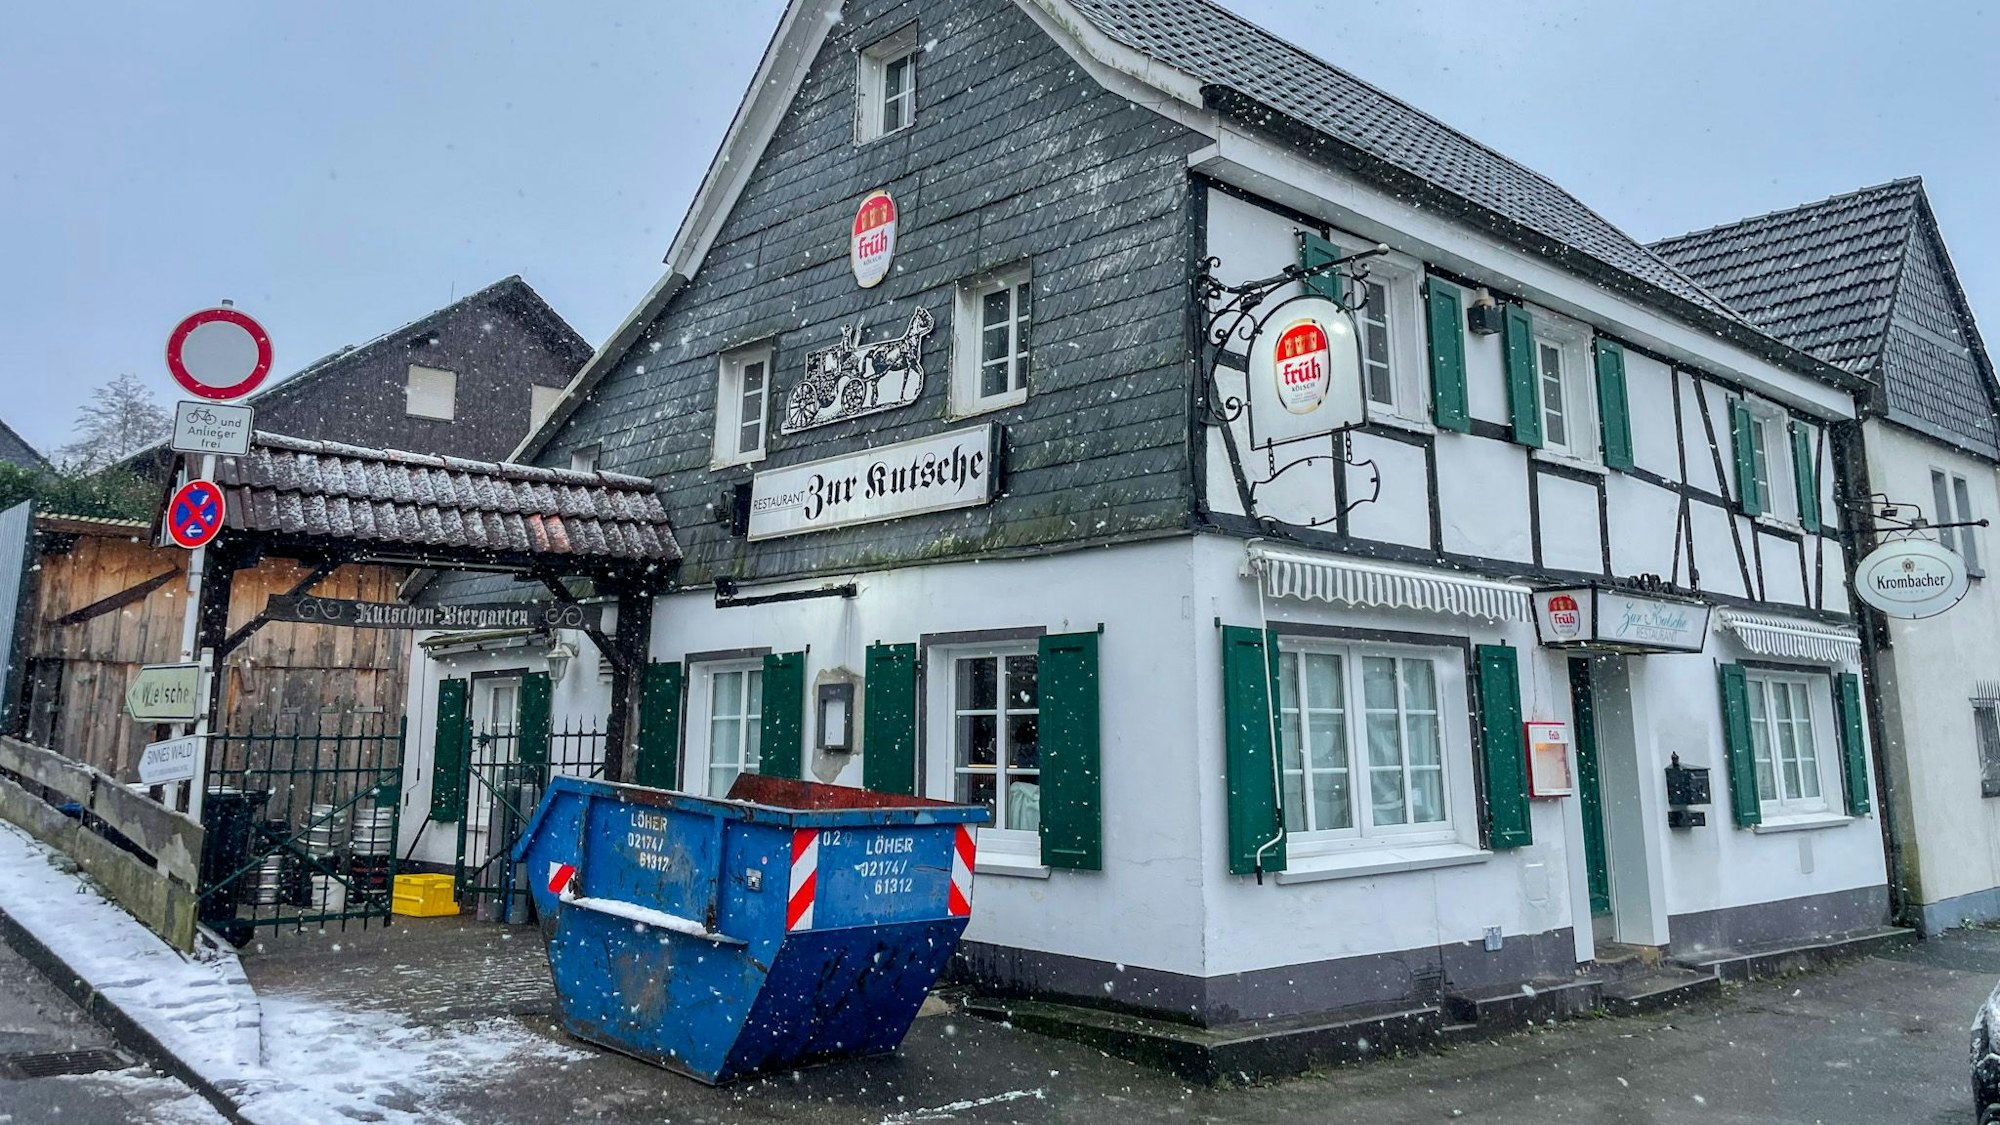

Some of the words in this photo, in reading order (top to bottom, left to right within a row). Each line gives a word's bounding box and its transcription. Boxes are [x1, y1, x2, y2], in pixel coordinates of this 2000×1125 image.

[220, 417, 242, 428] und
[187, 425, 237, 440] Anlieger
[201, 438, 221, 448] frei
[753, 490, 805, 512] RESTAURANT
[804, 474, 857, 521] Zur
[866, 443, 984, 500] Kutsche
[1876, 573, 1945, 590] Krombacher
[1636, 627, 1678, 642] RESTAURANT
[171, 742, 193, 760] WALD
[631, 810, 668, 832] LÖHER
[628, 832, 664, 852] 02174/
[866, 836, 914, 856] LÖHER
[640, 852, 669, 872] 61312
[860, 860, 908, 878] 02174/
[874, 878, 913, 895] 61312
